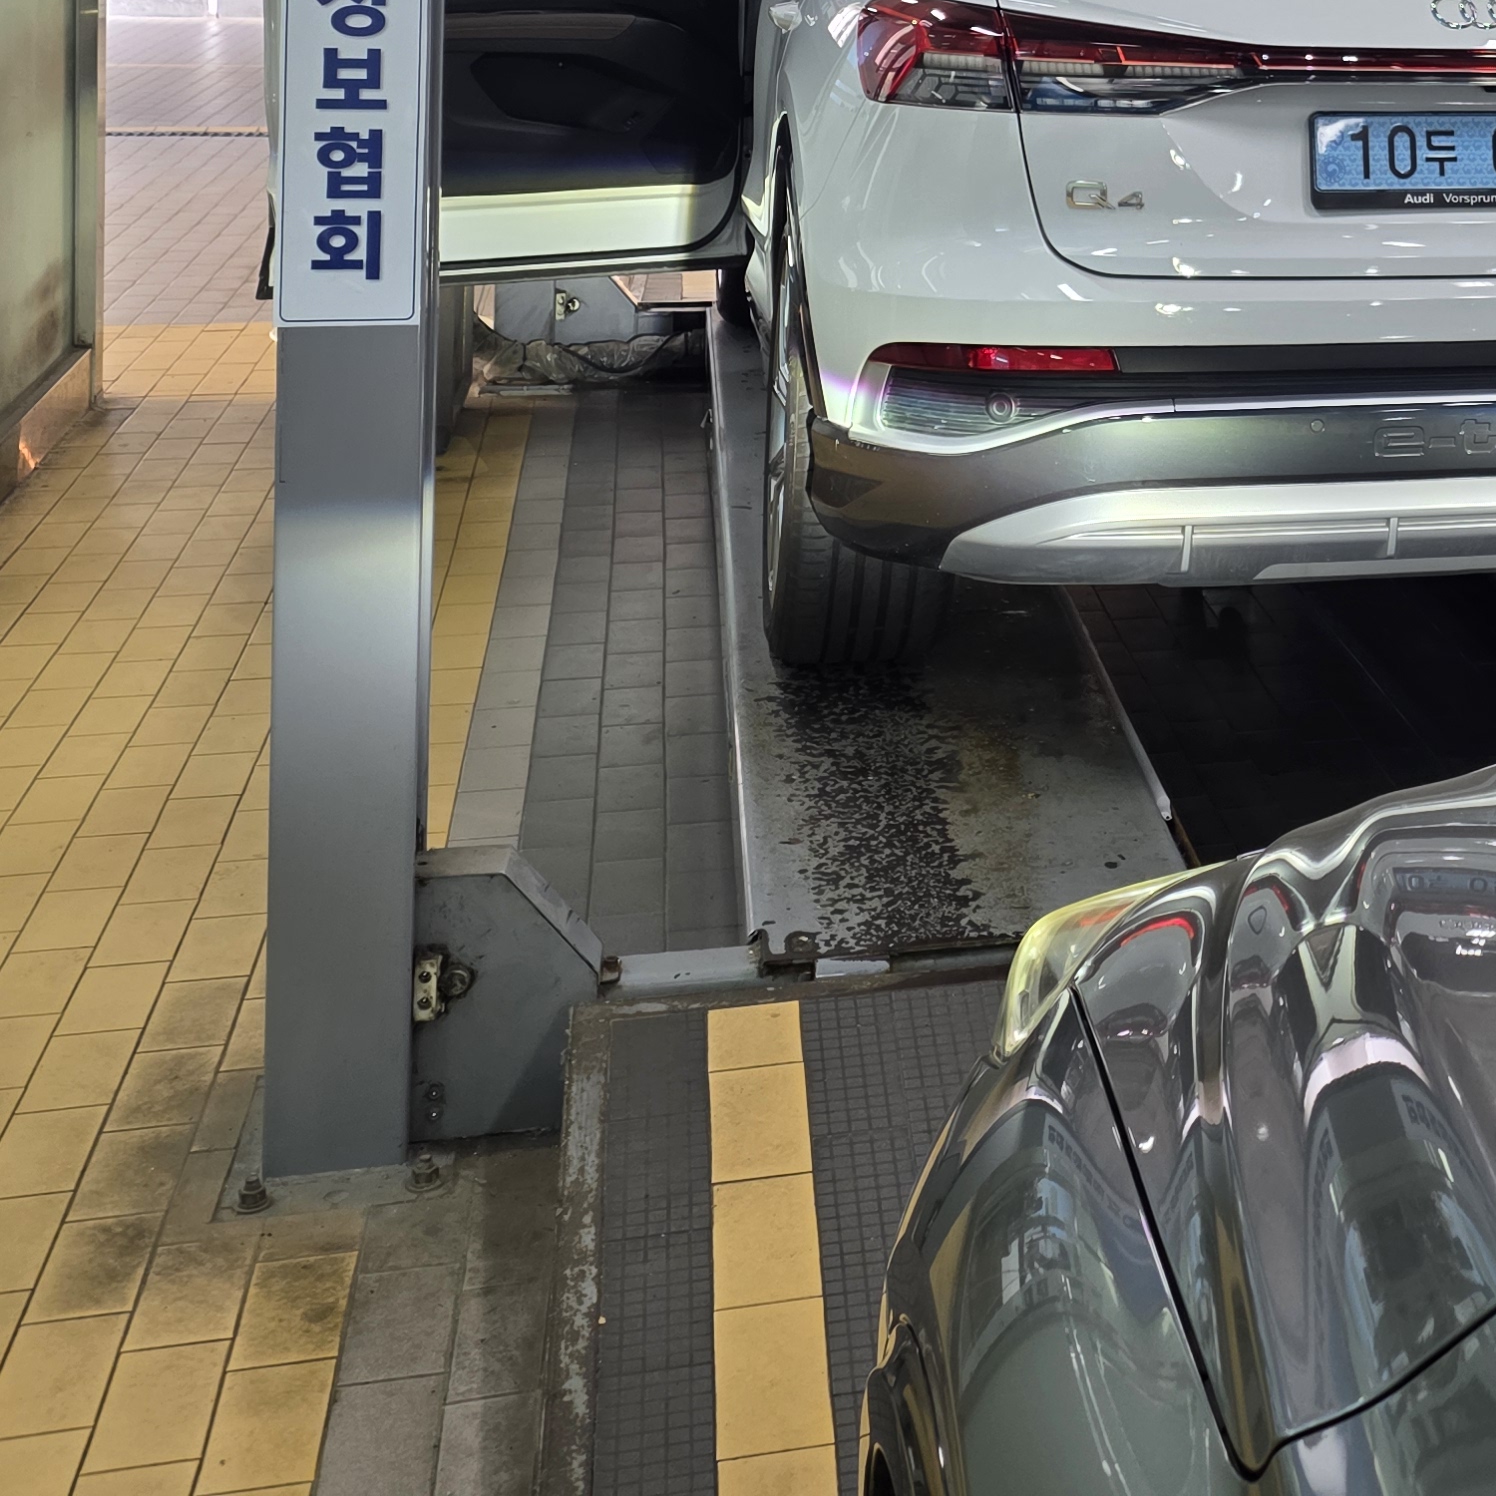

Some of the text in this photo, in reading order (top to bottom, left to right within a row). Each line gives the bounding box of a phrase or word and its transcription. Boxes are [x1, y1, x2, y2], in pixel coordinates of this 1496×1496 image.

[1350, 125, 1458, 180] 10두
[1066, 180, 1144, 210] Q4
[1404, 193, 1434, 204] Audi
